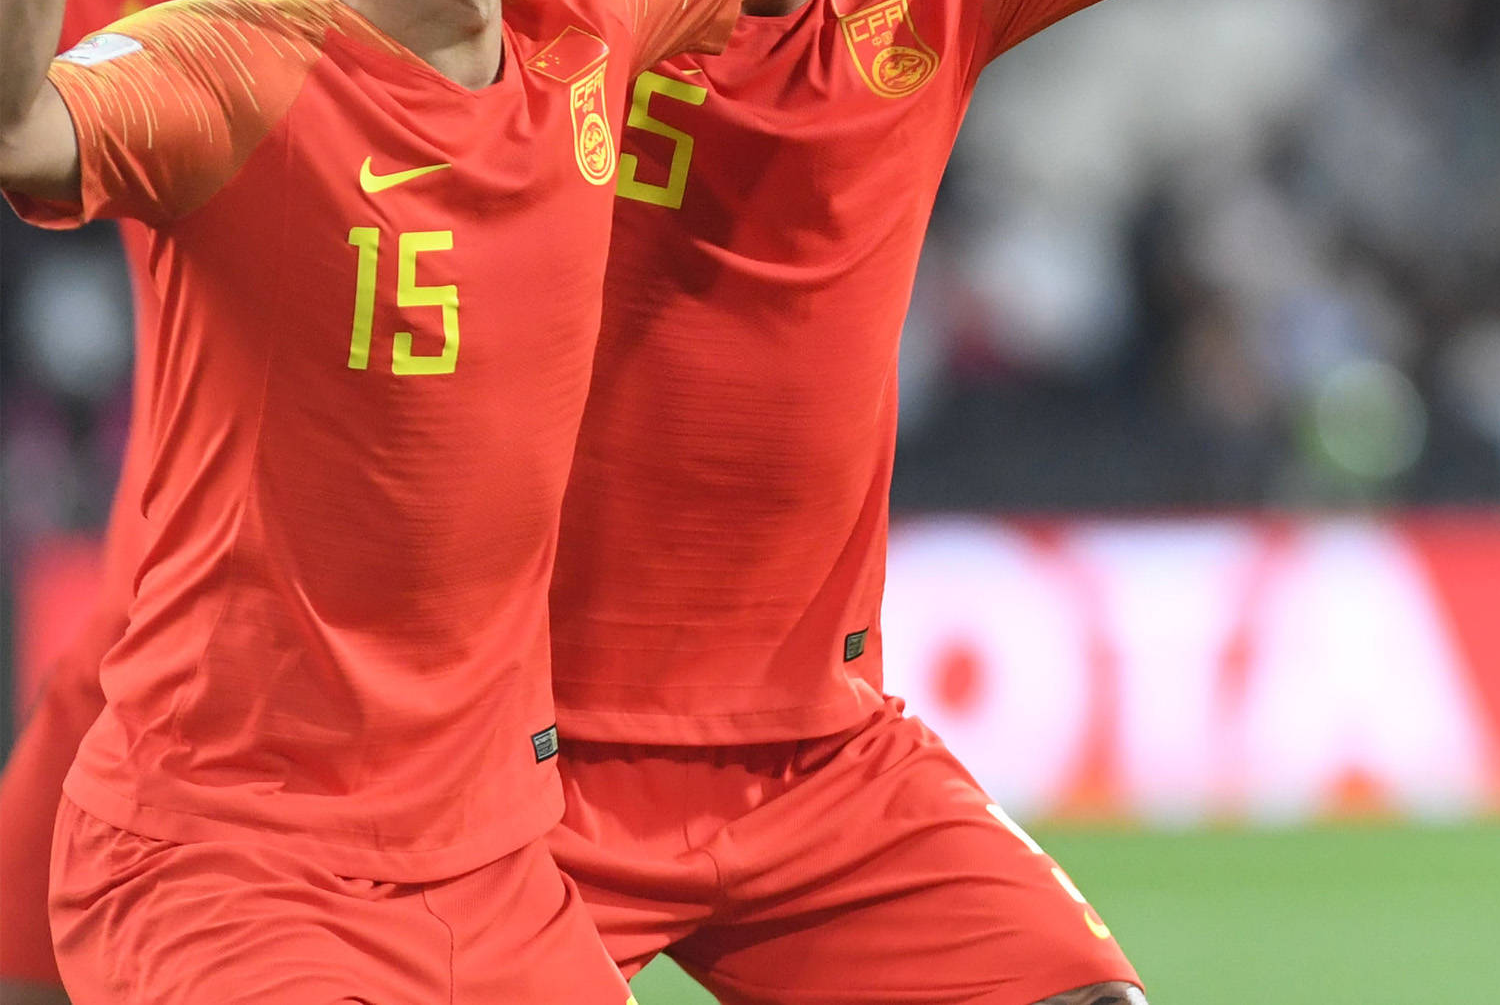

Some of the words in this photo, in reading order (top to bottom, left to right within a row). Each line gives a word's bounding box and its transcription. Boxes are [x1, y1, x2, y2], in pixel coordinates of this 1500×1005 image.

[849, 4, 904, 43] CFA
[574, 71, 604, 109] CFA
[616, 70, 708, 209] 5
[348, 227, 460, 375] 15
